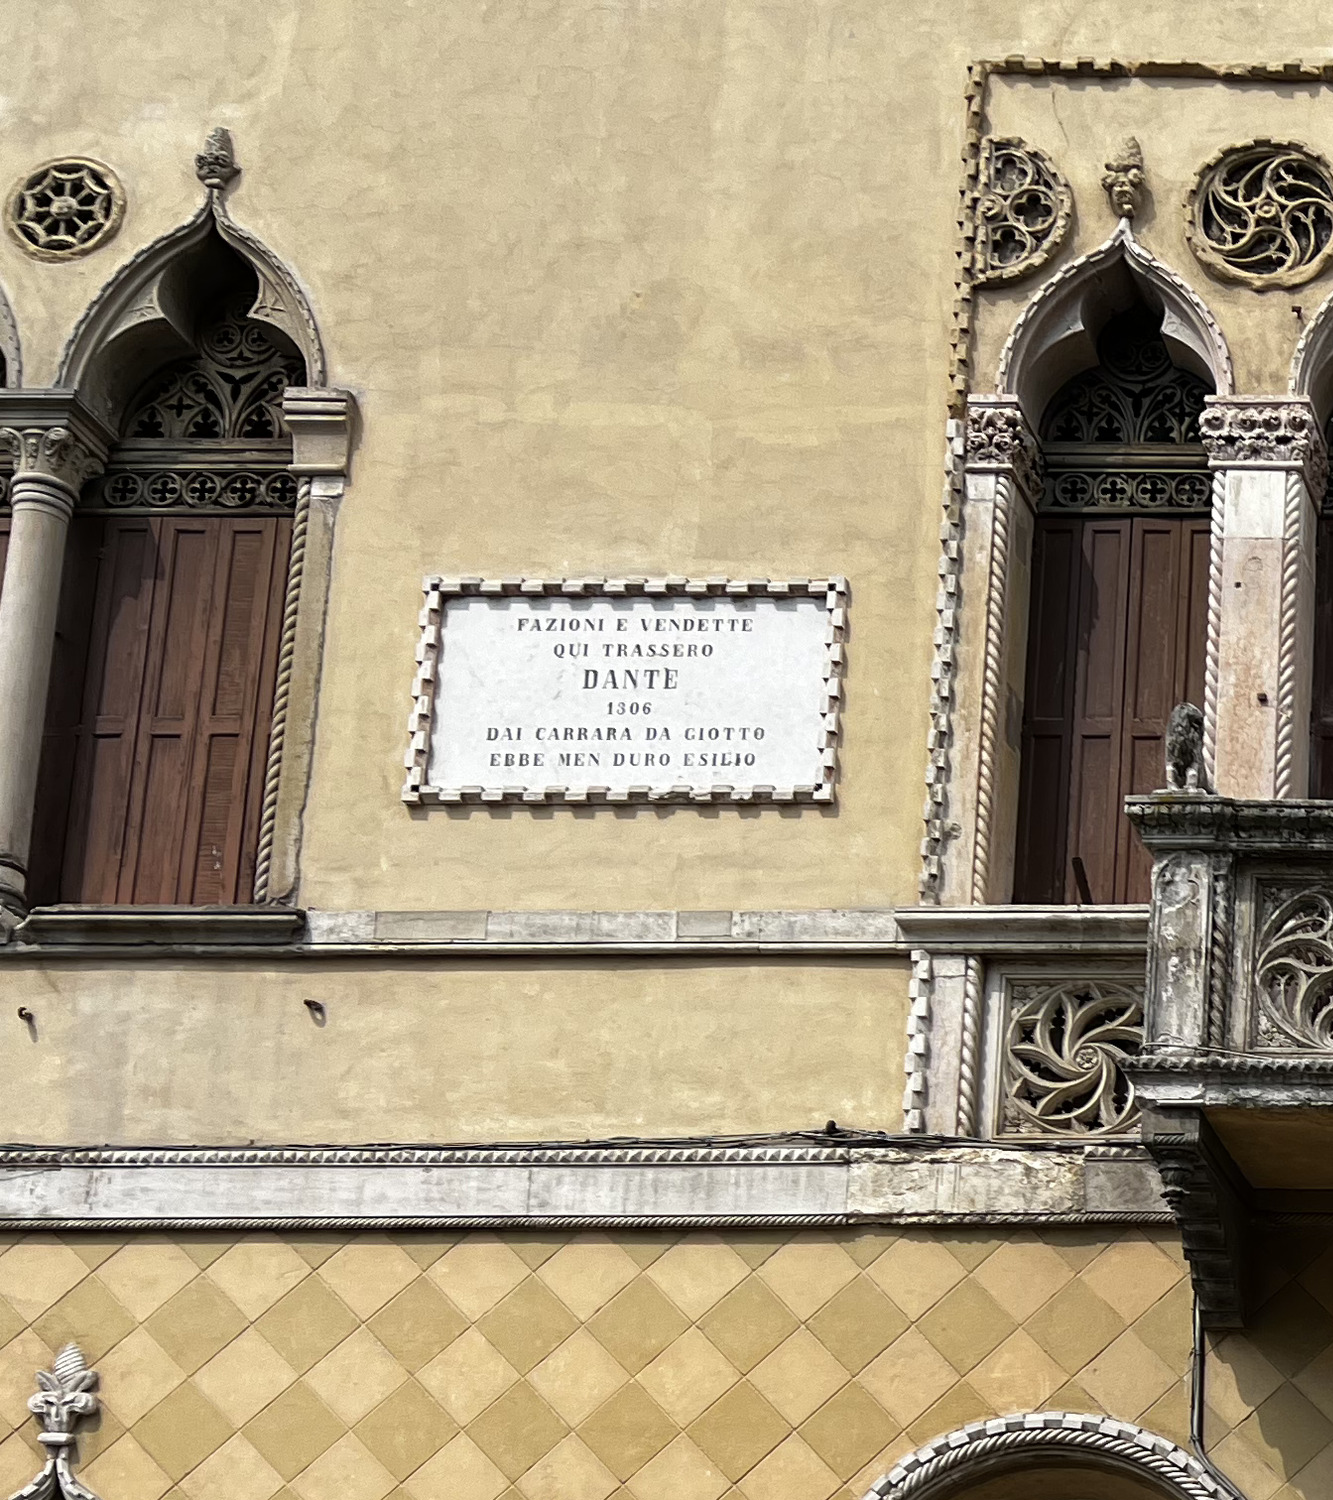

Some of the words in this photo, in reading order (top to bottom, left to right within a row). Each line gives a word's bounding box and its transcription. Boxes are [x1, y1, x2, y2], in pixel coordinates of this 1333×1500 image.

[516, 618, 604, 632] FAZIONI
[616, 618, 628, 632] E
[640, 618, 754, 632] VENDETTE
[553, 643, 589, 659] QUI
[602, 643, 714, 658] TRASSERO
[582, 668, 679, 690] DANTE
[606, 701, 652, 716] 1306
[486, 727, 523, 741] DAI
[535, 727, 633, 741] CARRARA
[645, 727, 672, 741] DA
[684, 727, 766, 741] GIOTTO
[489, 753, 546, 767] EBBE
[557, 753, 601, 767] MEN
[612, 753, 671, 767] DURO
[683, 752, 757, 767] ESILIO
